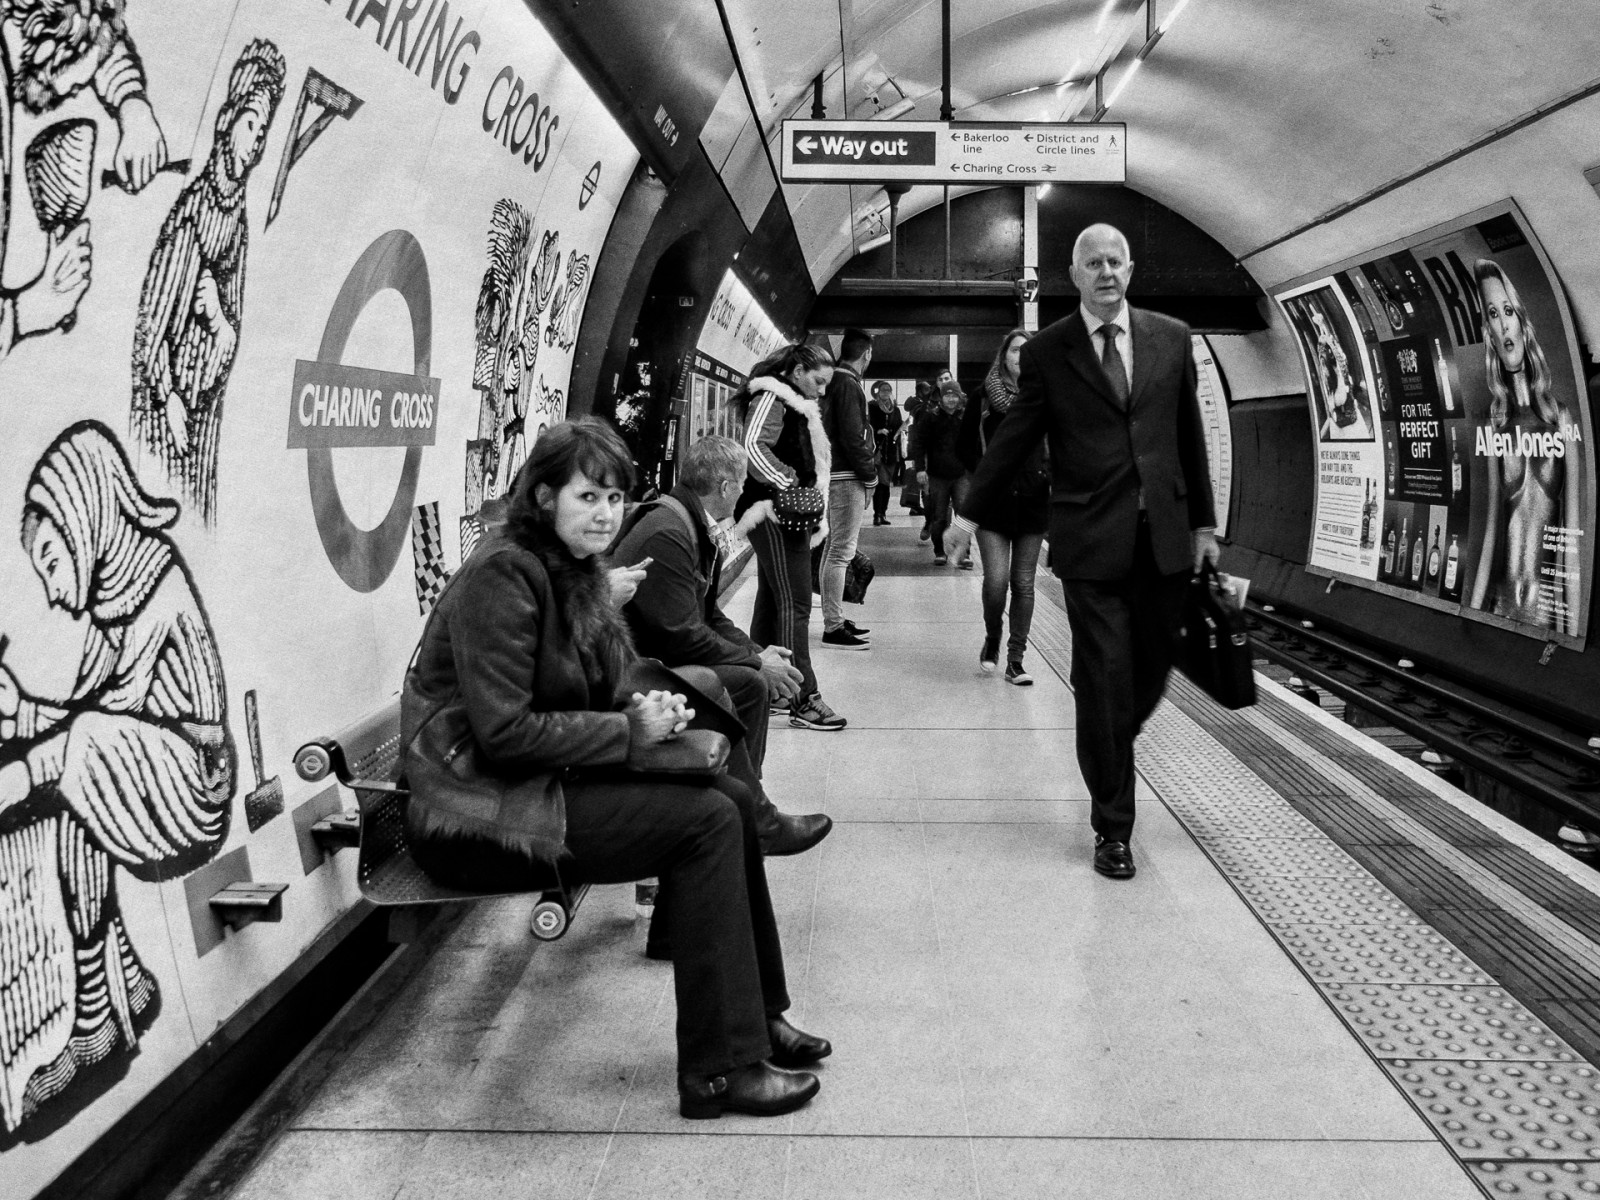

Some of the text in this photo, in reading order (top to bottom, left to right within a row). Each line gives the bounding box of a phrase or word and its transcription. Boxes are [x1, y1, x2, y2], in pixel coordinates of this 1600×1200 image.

[482, 65, 560, 173] CROSS
[963, 132, 1010, 143] Bakerloo
[1036, 133, 1099, 144] District and
[820, 135, 909, 160] Way out
[962, 144, 983, 154] line
[1036, 145, 1067, 155] Circle
[1070, 145, 1096, 155] lines
[962, 163, 1037, 175] Charing Cross
[299, 383, 434, 429] CHARING CROSS
[1401, 403, 1433, 418] FOR THE
[1400, 421, 1439, 438] PERFECT
[1475, 423, 1582, 458] Allen Jones RA
[1411, 441, 1432, 459] GIFT
[1541, 566, 1550, 575] Until
[1550, 568, 1556, 576] 25
